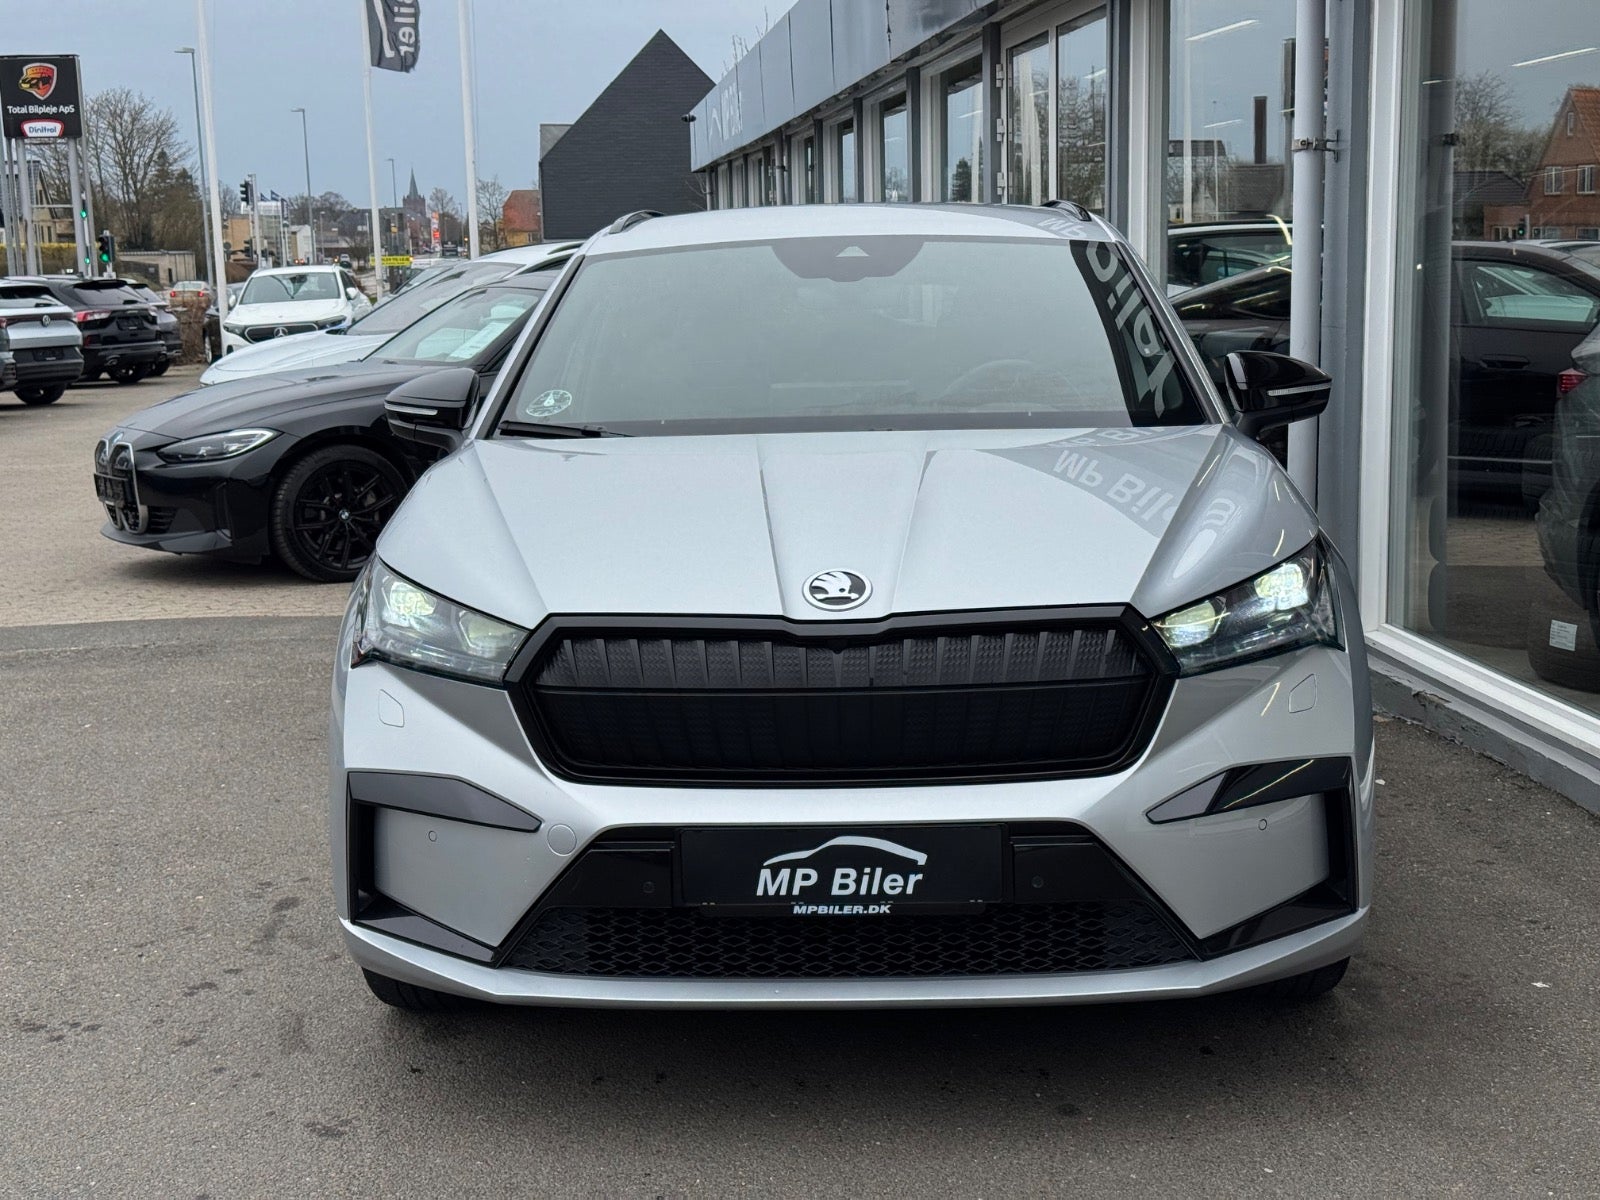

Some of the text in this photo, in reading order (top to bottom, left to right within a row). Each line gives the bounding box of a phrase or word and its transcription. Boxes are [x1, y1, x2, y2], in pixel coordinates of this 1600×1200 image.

[7, 104, 75, 115] Total Bilpleje ApS
[756, 867, 923, 896] MP Biler
[793, 903, 892, 914] MPBILER.DK
